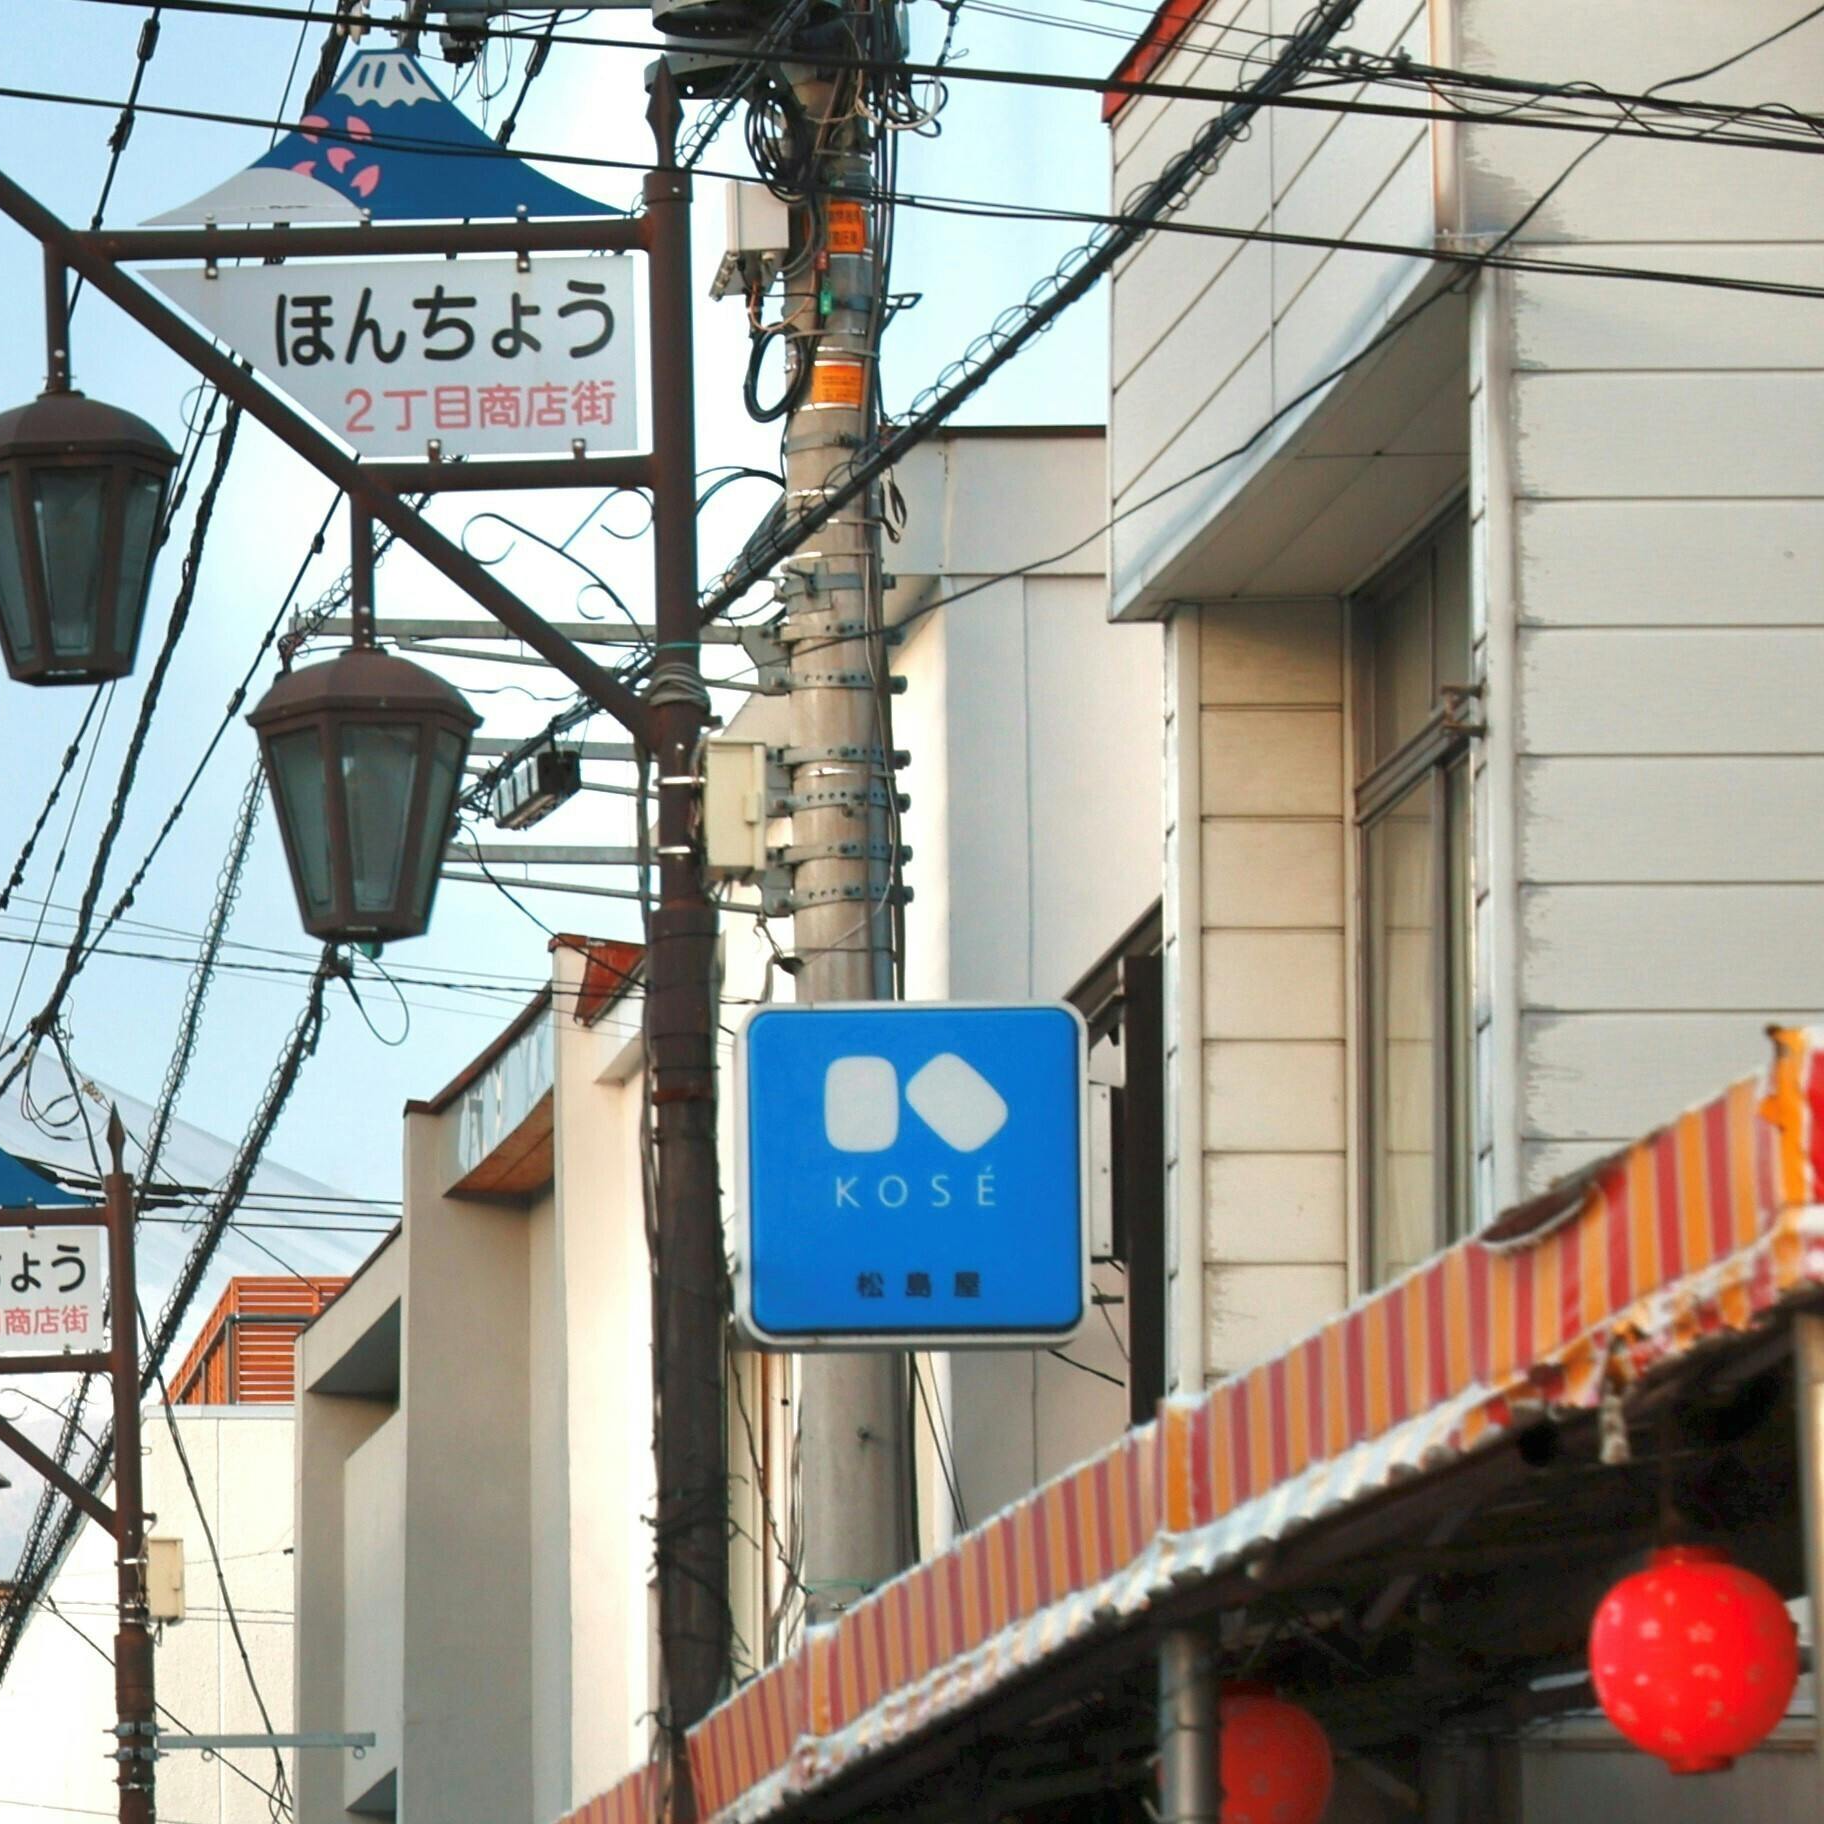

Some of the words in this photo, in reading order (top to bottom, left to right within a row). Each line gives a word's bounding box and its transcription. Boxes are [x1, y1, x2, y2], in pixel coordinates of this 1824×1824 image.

[275, 280, 616, 368] ほんちょう
[344, 380, 618, 433] 2丁目商店街
[833, 1166, 1000, 1208] KOSÉ
[855, 1272, 983, 1299] 松島屋
